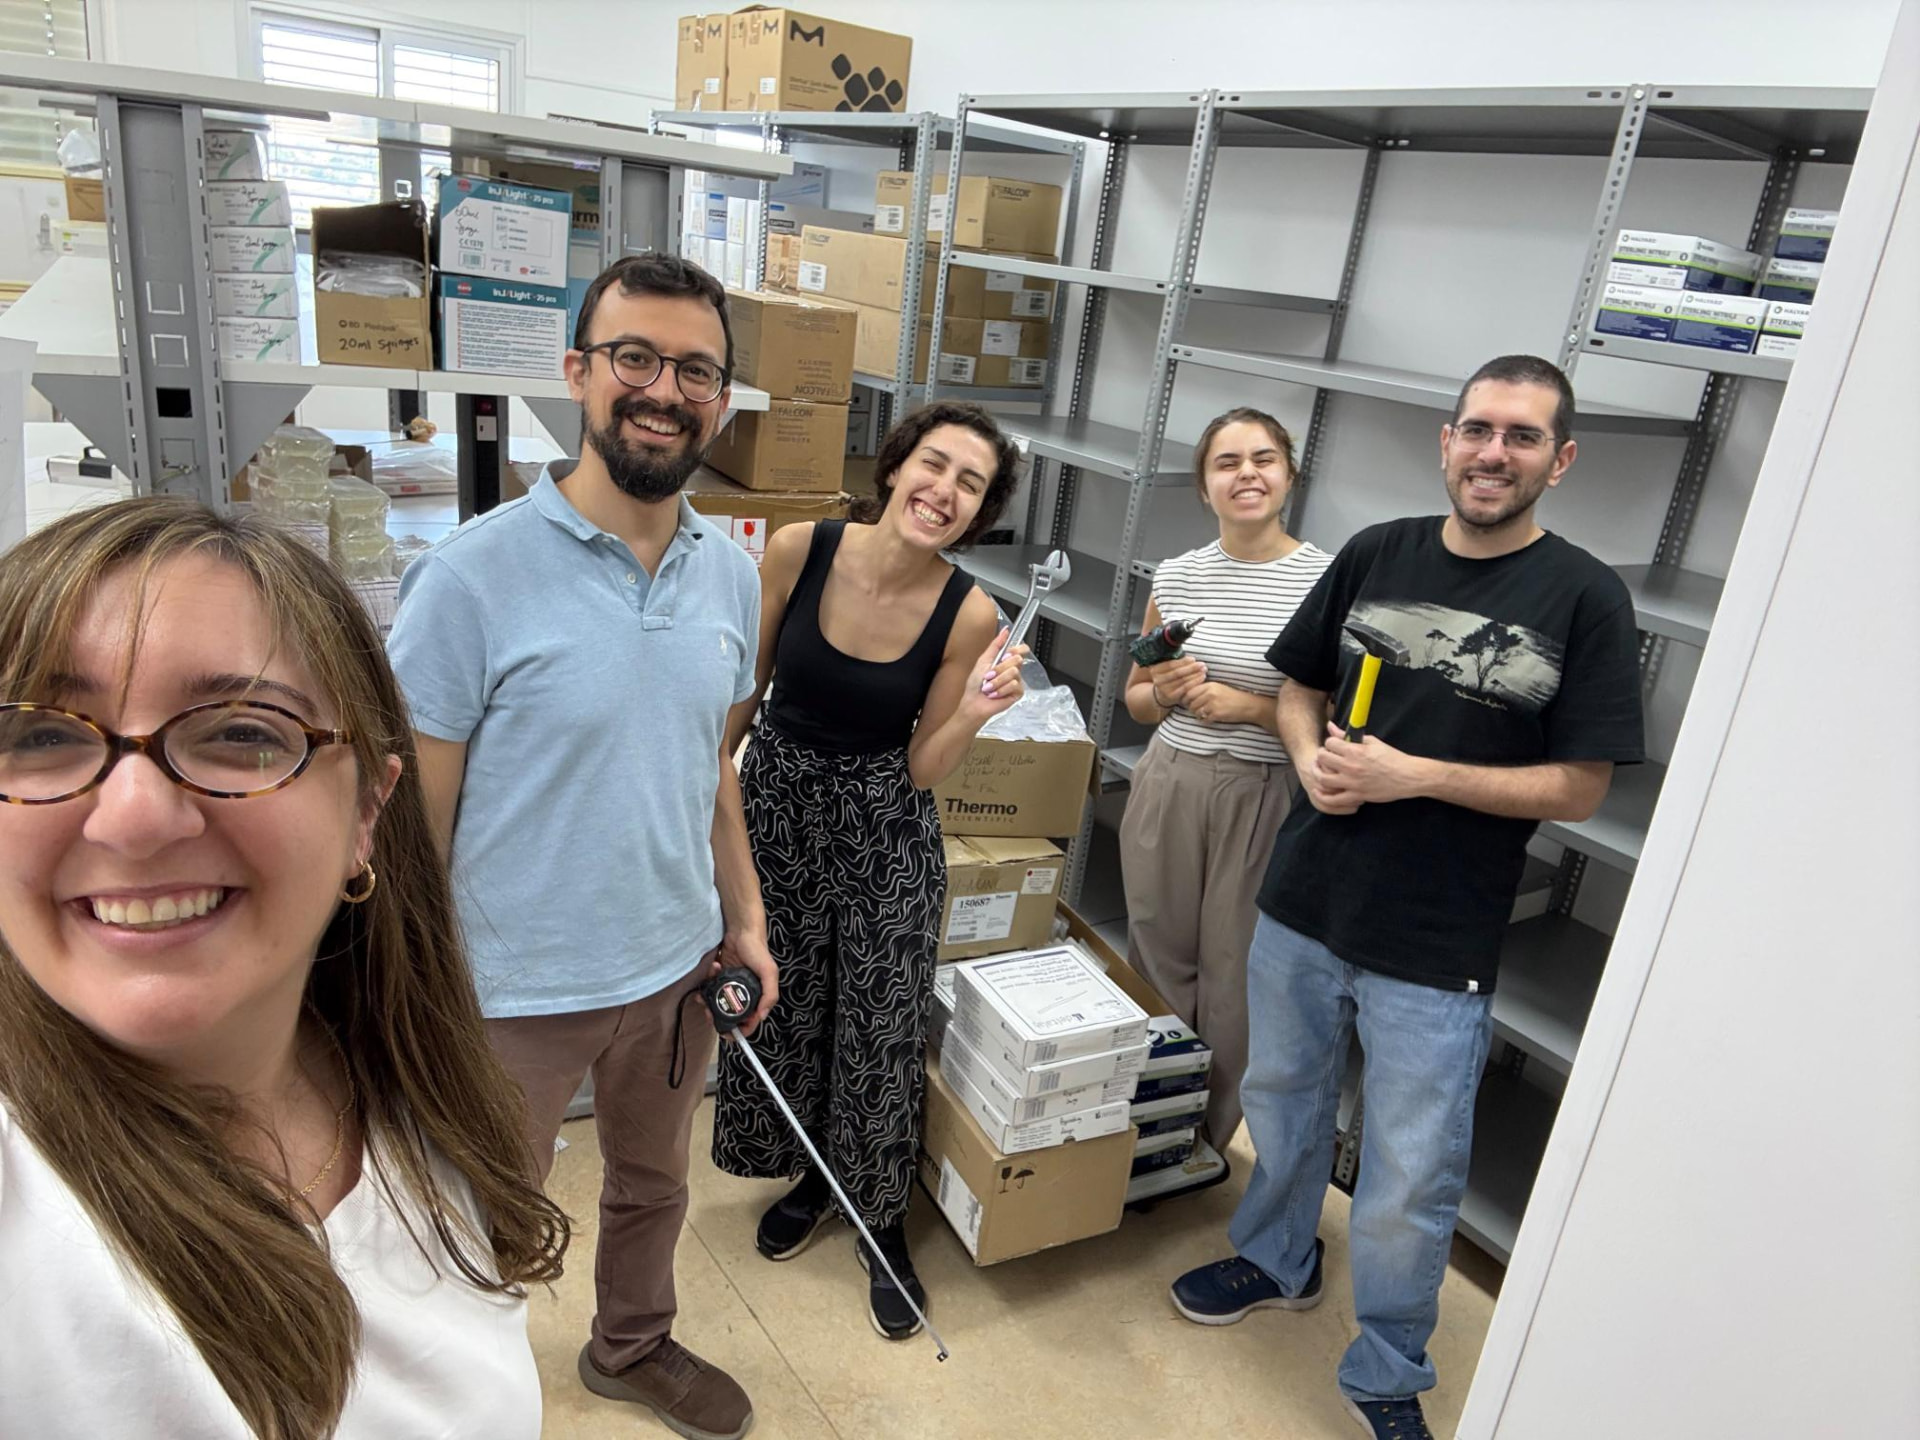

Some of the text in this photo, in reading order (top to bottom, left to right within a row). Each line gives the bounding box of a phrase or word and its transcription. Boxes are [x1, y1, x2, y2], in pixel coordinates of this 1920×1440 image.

[1784, 308, 1810, 316] HALYAR
[776, 407, 814, 417] FALCON
[945, 797, 1018, 816] Thermo
[946, 815, 1015, 824] SCIENTIFIC
[960, 897, 991, 909] 150687
